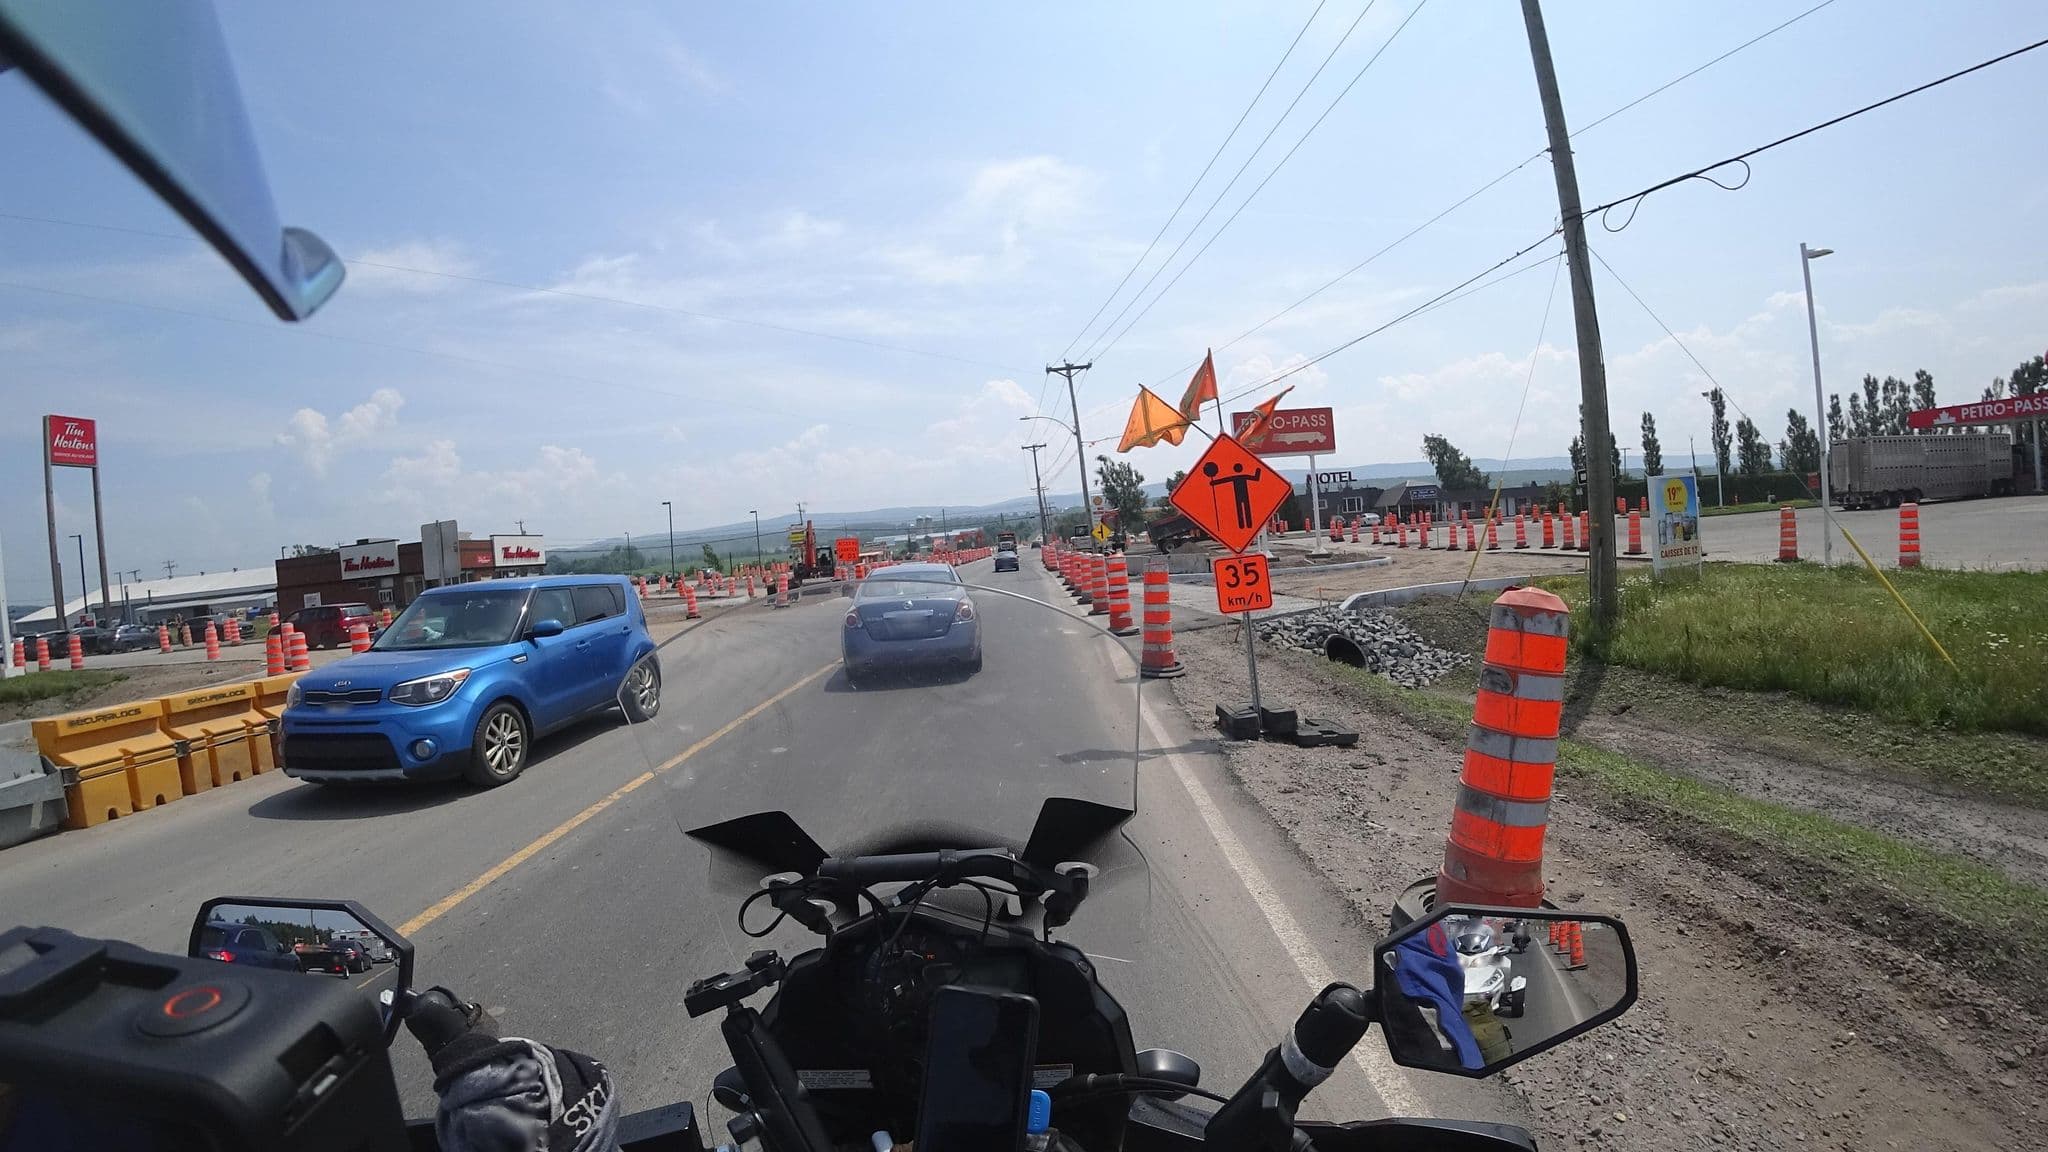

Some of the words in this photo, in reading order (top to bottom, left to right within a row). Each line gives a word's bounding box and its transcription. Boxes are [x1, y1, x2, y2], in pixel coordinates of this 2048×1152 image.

[1961, 396, 2048, 419] PETRO-PASS
[65, 422, 85, 437] Tim
[53, 434, 94, 450] Hortons
[1661, 548, 1683, 558] CAISSES
[342, 558, 360, 572] Tim
[360, 556, 395, 570] Hortons
[1225, 562, 1260, 588] 35
[1227, 592, 1263, 607] km/h
